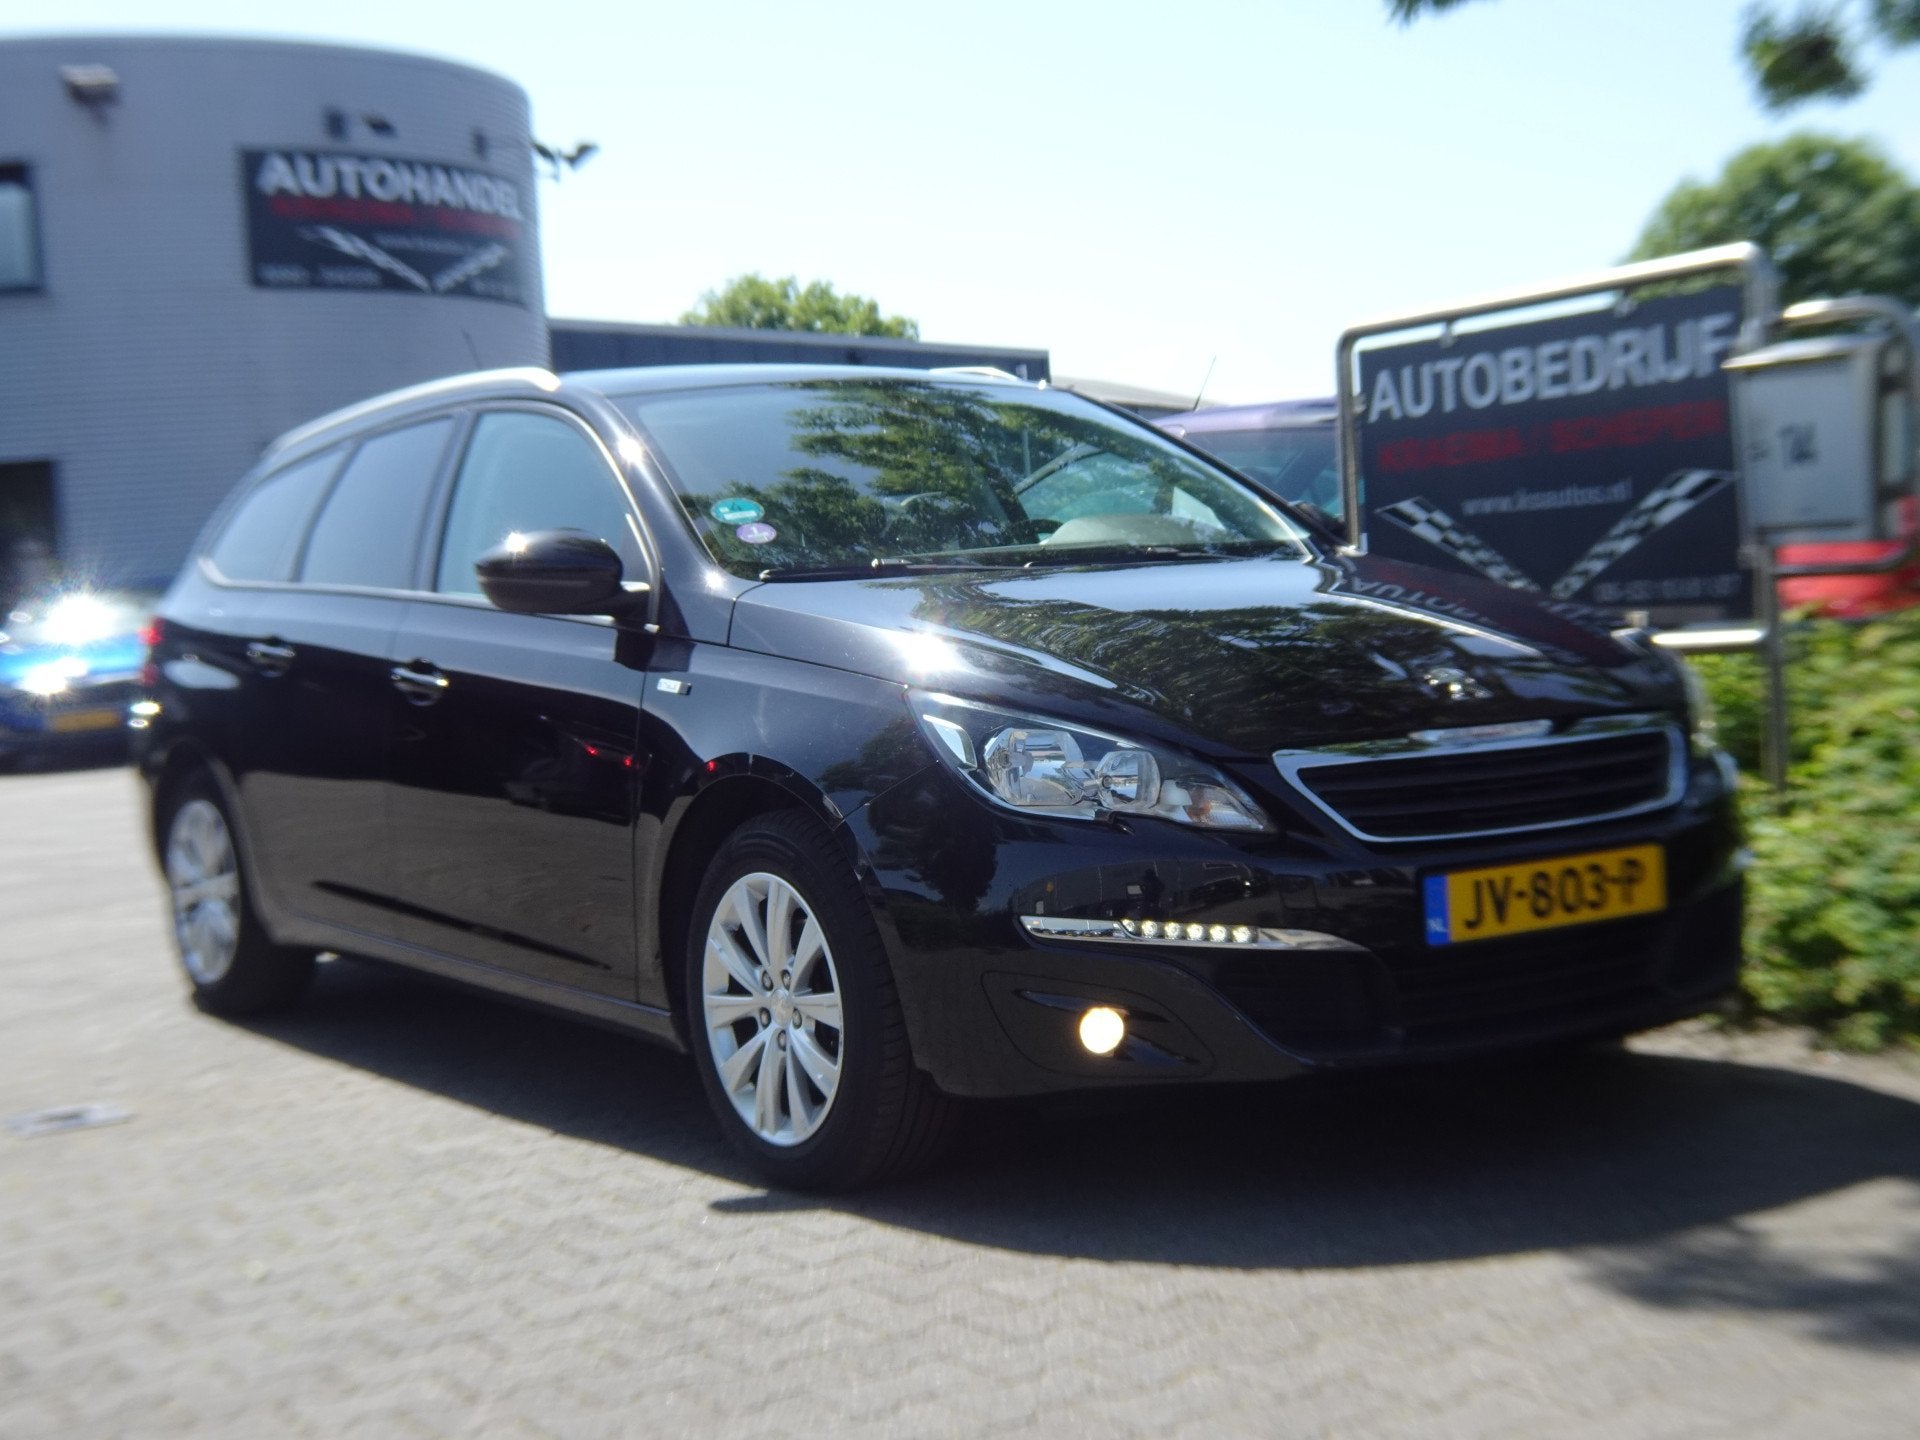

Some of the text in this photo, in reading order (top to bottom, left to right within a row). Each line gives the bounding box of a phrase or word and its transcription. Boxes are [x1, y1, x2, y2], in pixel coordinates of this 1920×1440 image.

[256, 152, 524, 221] AUTOHANDEL
[1369, 312, 1734, 423] AUTOBEDRIJF
[1464, 858, 1647, 930] JV-803-P
